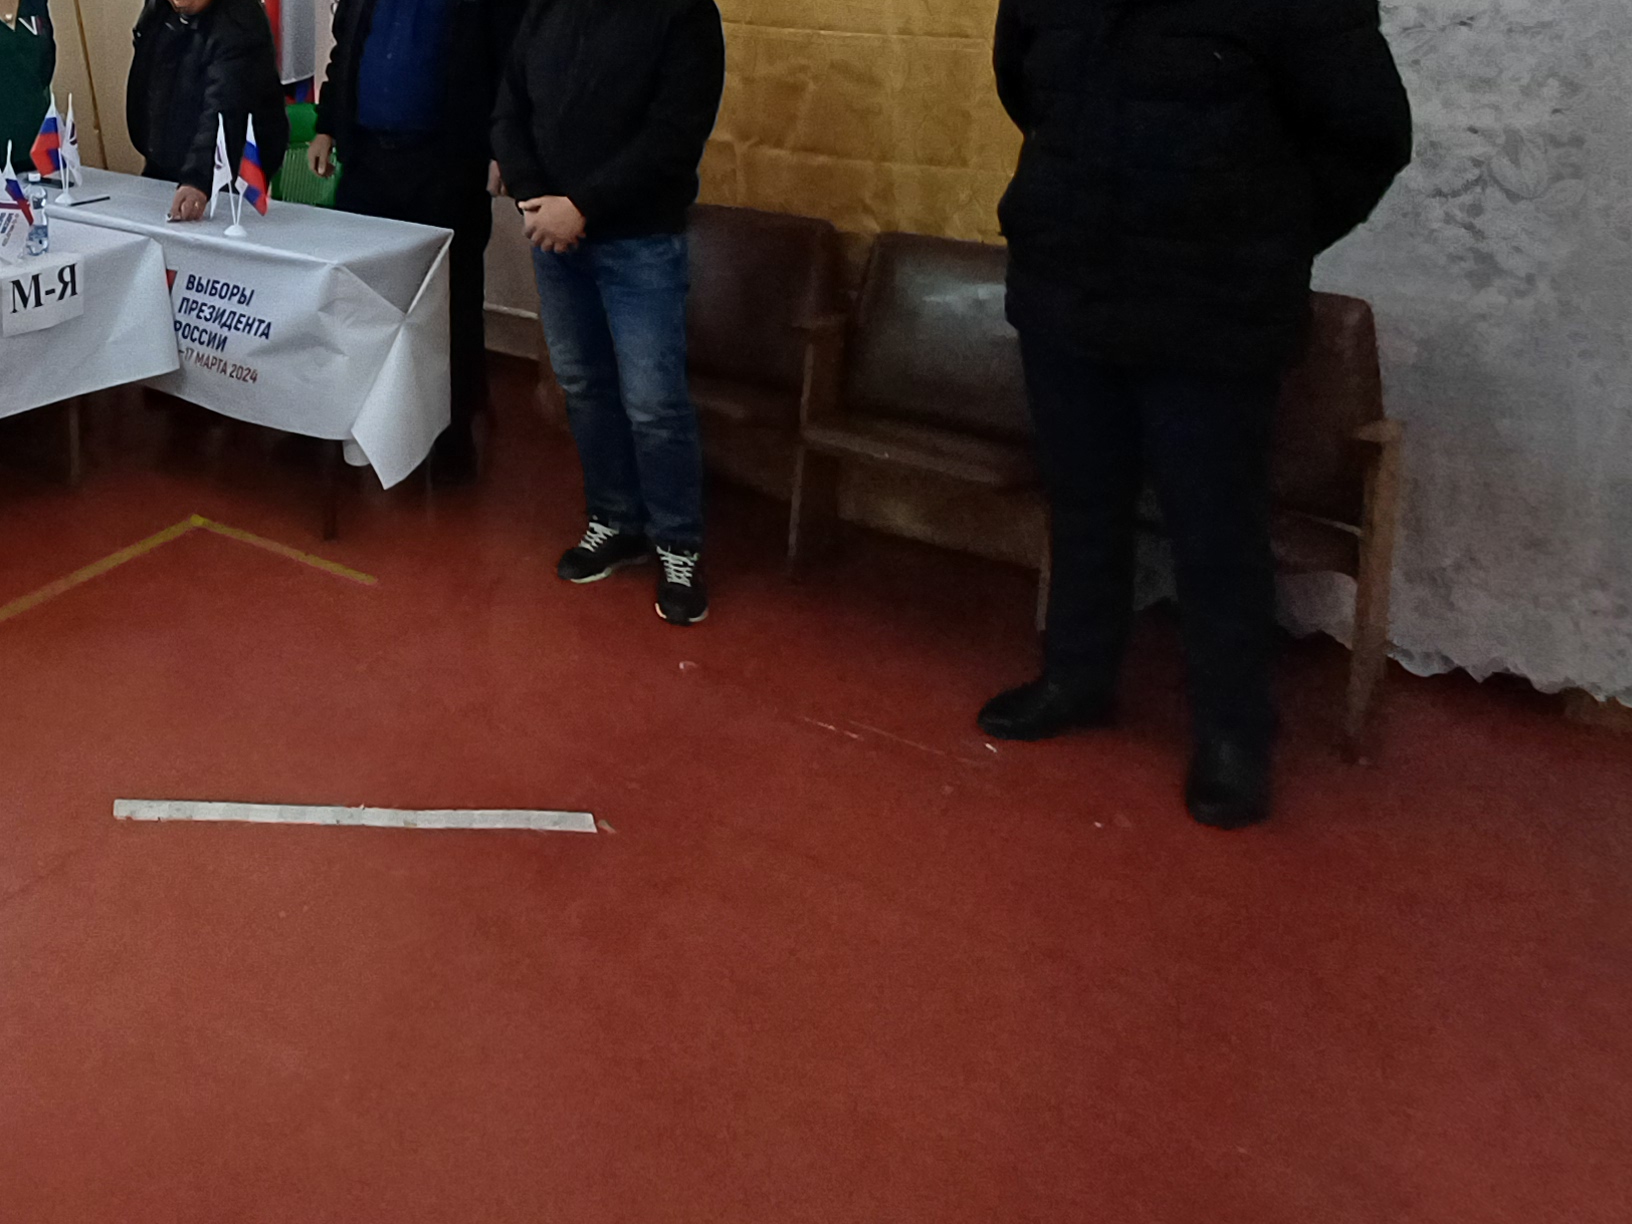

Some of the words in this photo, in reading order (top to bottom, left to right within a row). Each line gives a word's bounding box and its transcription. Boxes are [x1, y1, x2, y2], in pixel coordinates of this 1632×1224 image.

[9, 263, 79, 315] М-Я
[185, 274, 256, 306] ВЫБОРЫ
[178, 297, 272, 340] ПРЕЗИДЕНТА
[195, 354, 229, 376] МАРТА
[229, 363, 259, 384] 2024
